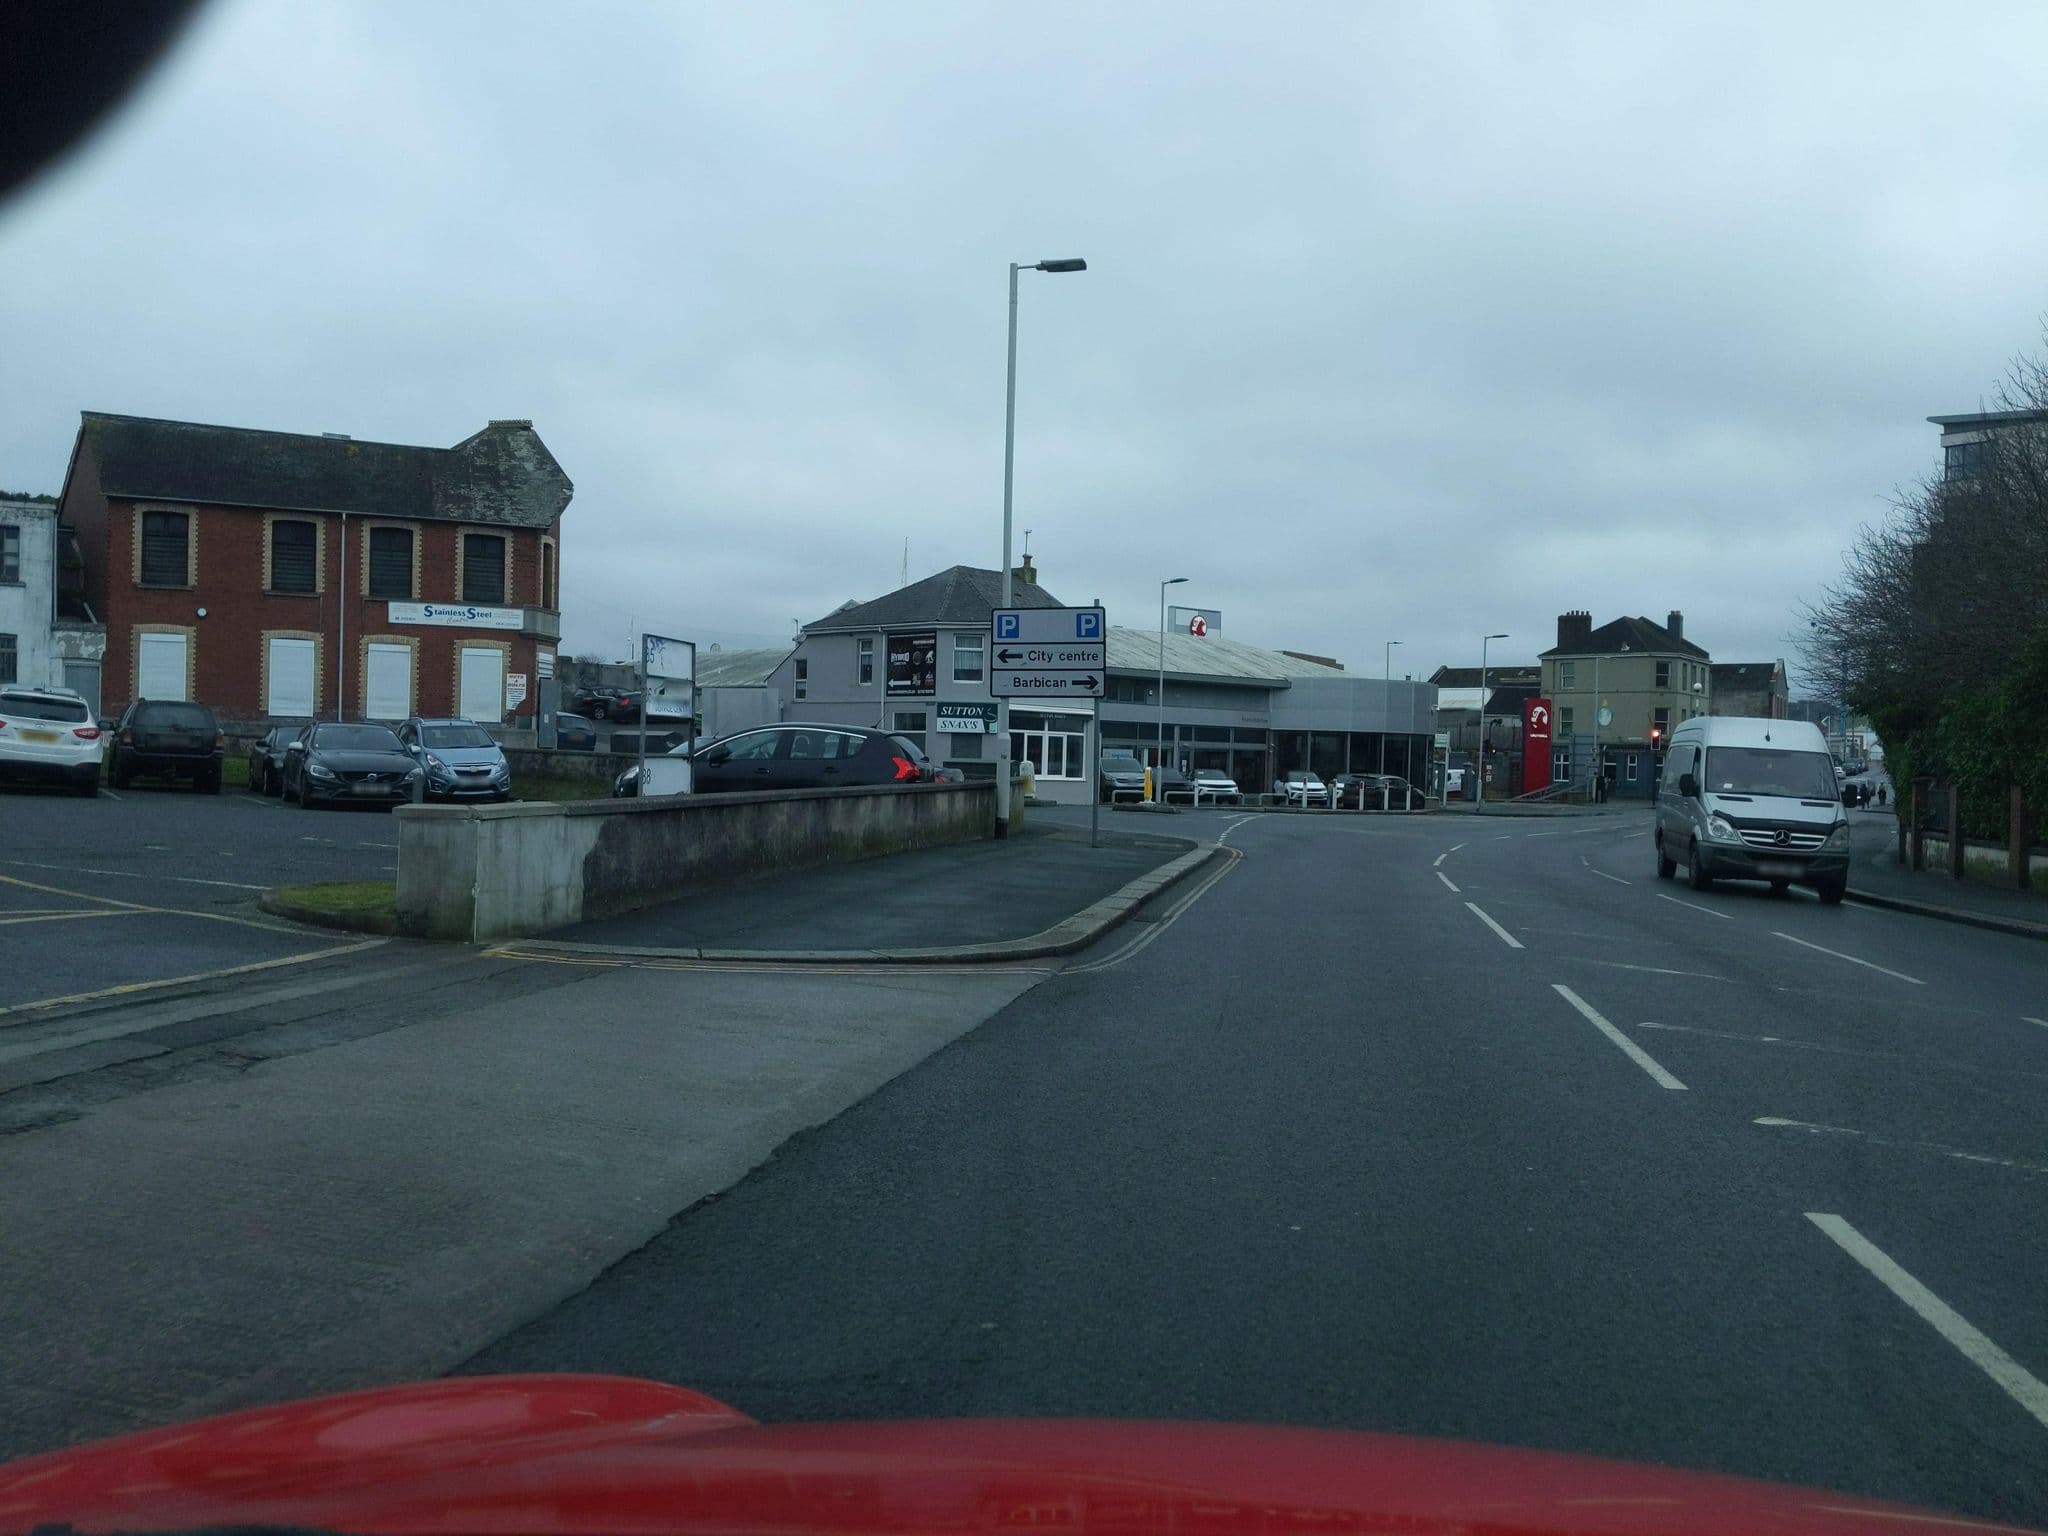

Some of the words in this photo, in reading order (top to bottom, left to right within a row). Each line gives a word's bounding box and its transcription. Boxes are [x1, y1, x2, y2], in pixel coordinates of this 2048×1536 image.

[423, 605, 466, 618] Stainless
[467, 607, 492, 620] Steel
[1001, 616, 1017, 637] P
[1080, 615, 1097, 636] P
[1027, 650, 1053, 663] City
[1058, 651, 1099, 662] centre
[1012, 676, 1067, 688] Barbican
[940, 706, 984, 716] SUTTON
[940, 720, 979, 730] SNAX'S
